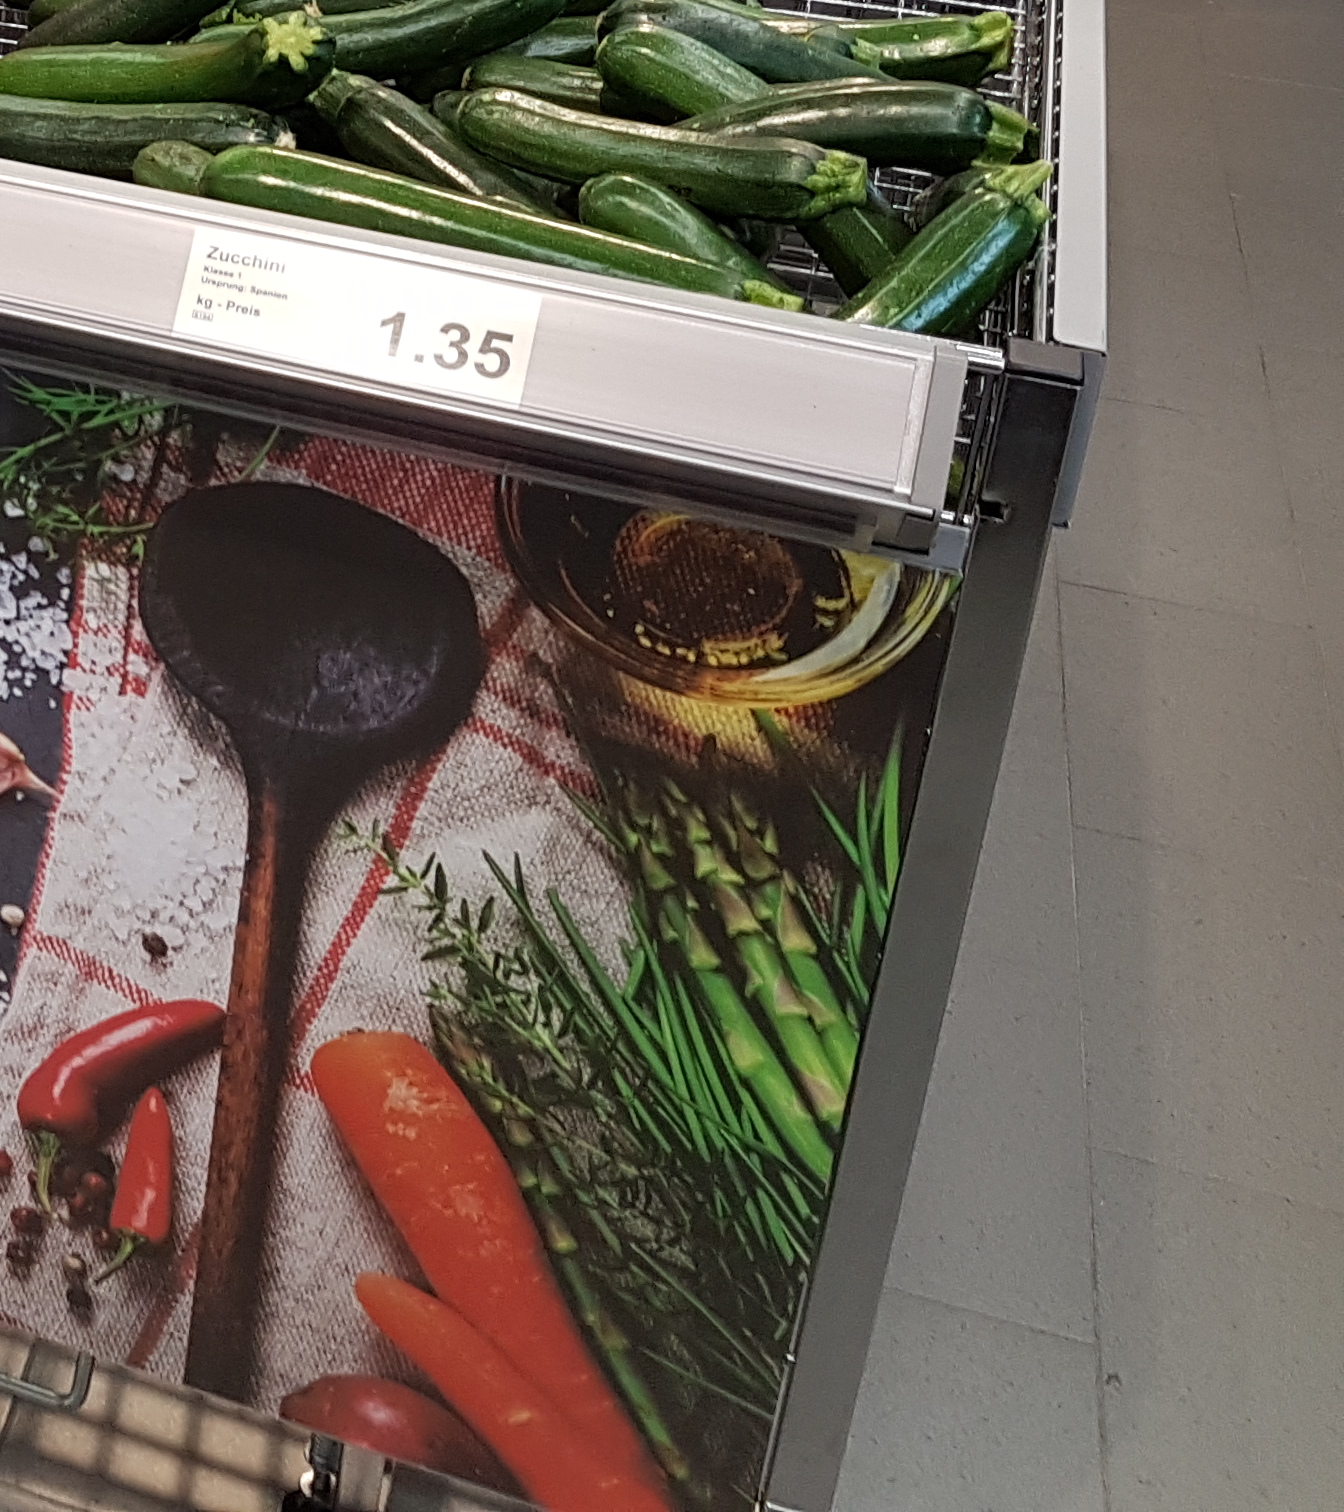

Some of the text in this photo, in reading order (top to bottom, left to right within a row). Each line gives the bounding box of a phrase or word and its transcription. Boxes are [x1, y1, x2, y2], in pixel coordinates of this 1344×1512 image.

[203, 265, 234, 278] Klasse
[206, 245, 286, 274] Zucchini
[201, 276, 288, 300] Ursprung: Spanien
[196, 294, 213, 309] kg
[226, 300, 261, 317] Preis
[380, 311, 514, 380] 1.35
